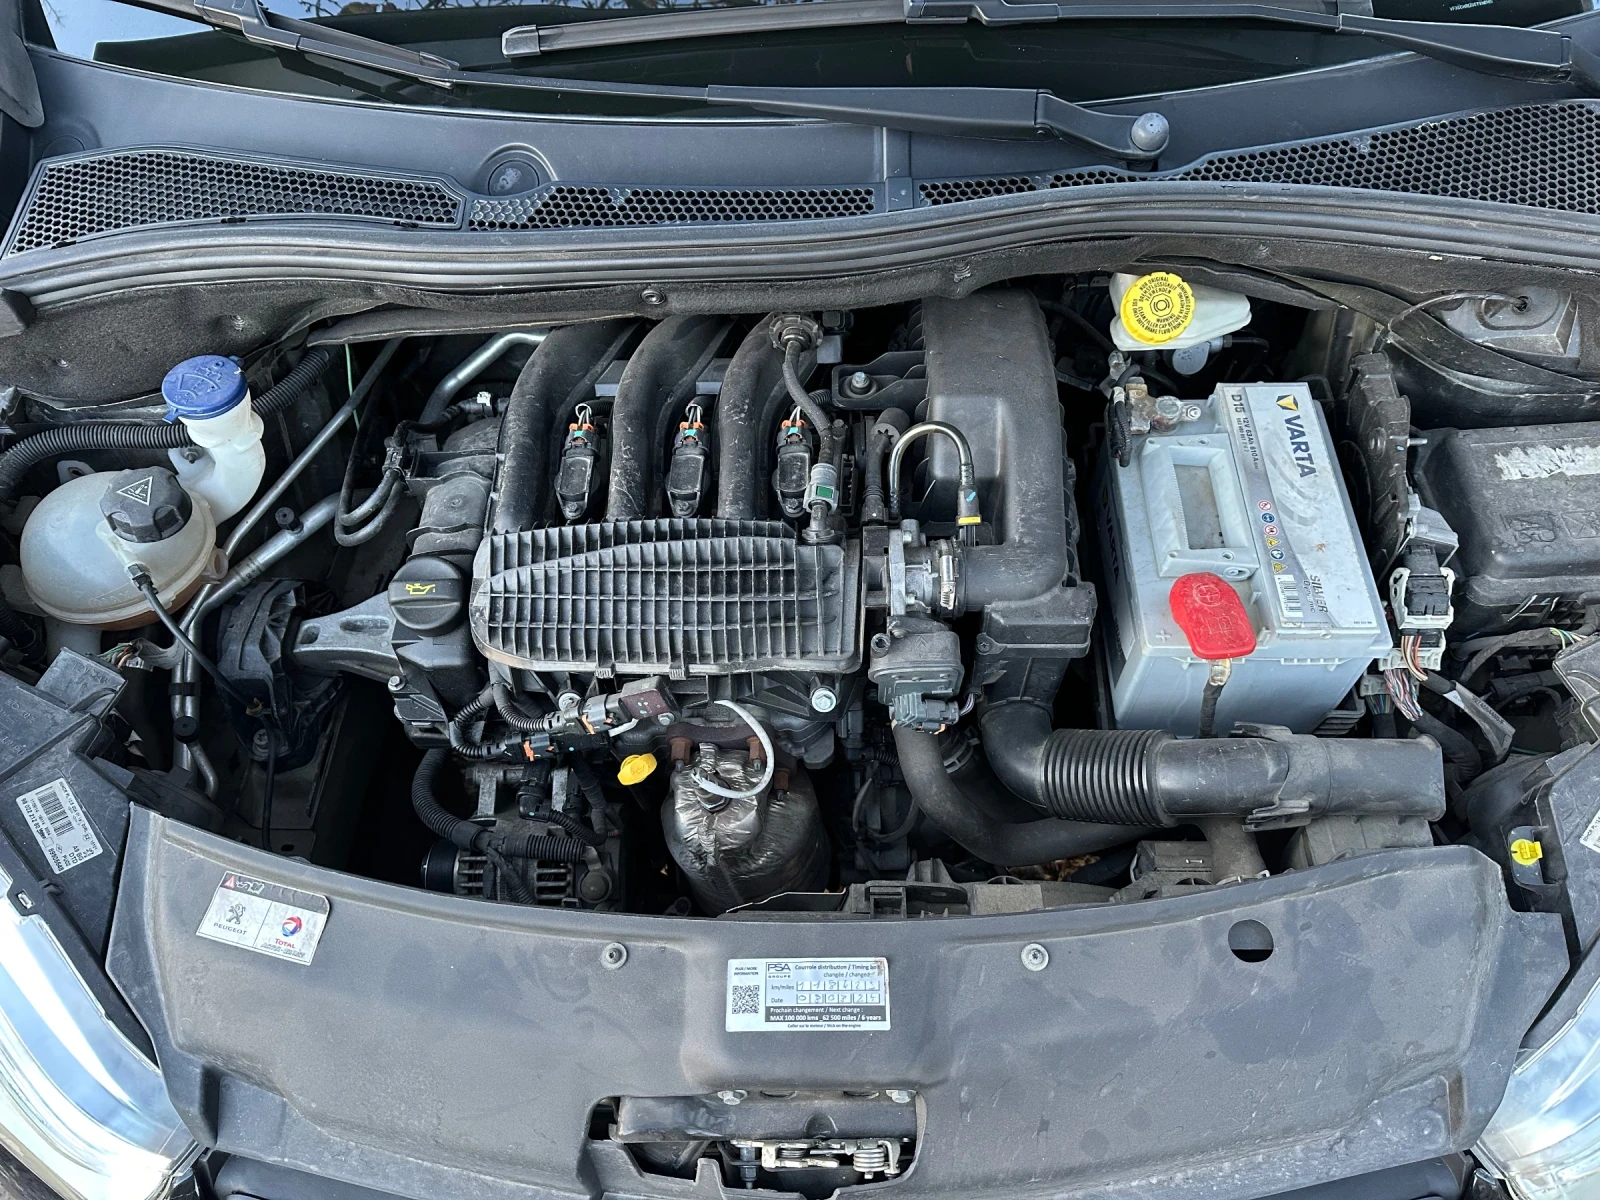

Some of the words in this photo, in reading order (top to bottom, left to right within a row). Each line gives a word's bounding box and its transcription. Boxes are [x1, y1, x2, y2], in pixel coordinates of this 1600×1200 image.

[1144, 318, 1158, 328] FILLER
[1168, 314, 1181, 326] BEFORE
[1157, 313, 1175, 322] WARNING
[1144, 325, 1157, 334] BRAKE
[1171, 322, 1181, 331] FROM
[1230, 394, 1246, 412] D15
[1284, 414, 1316, 478] VARTA
[1310, 574, 1328, 614] SILVER
[214, 922, 248, 936] PEUGEOT
[275, 938, 296, 949] TOTAL
[768, 963, 792, 971] PSA
